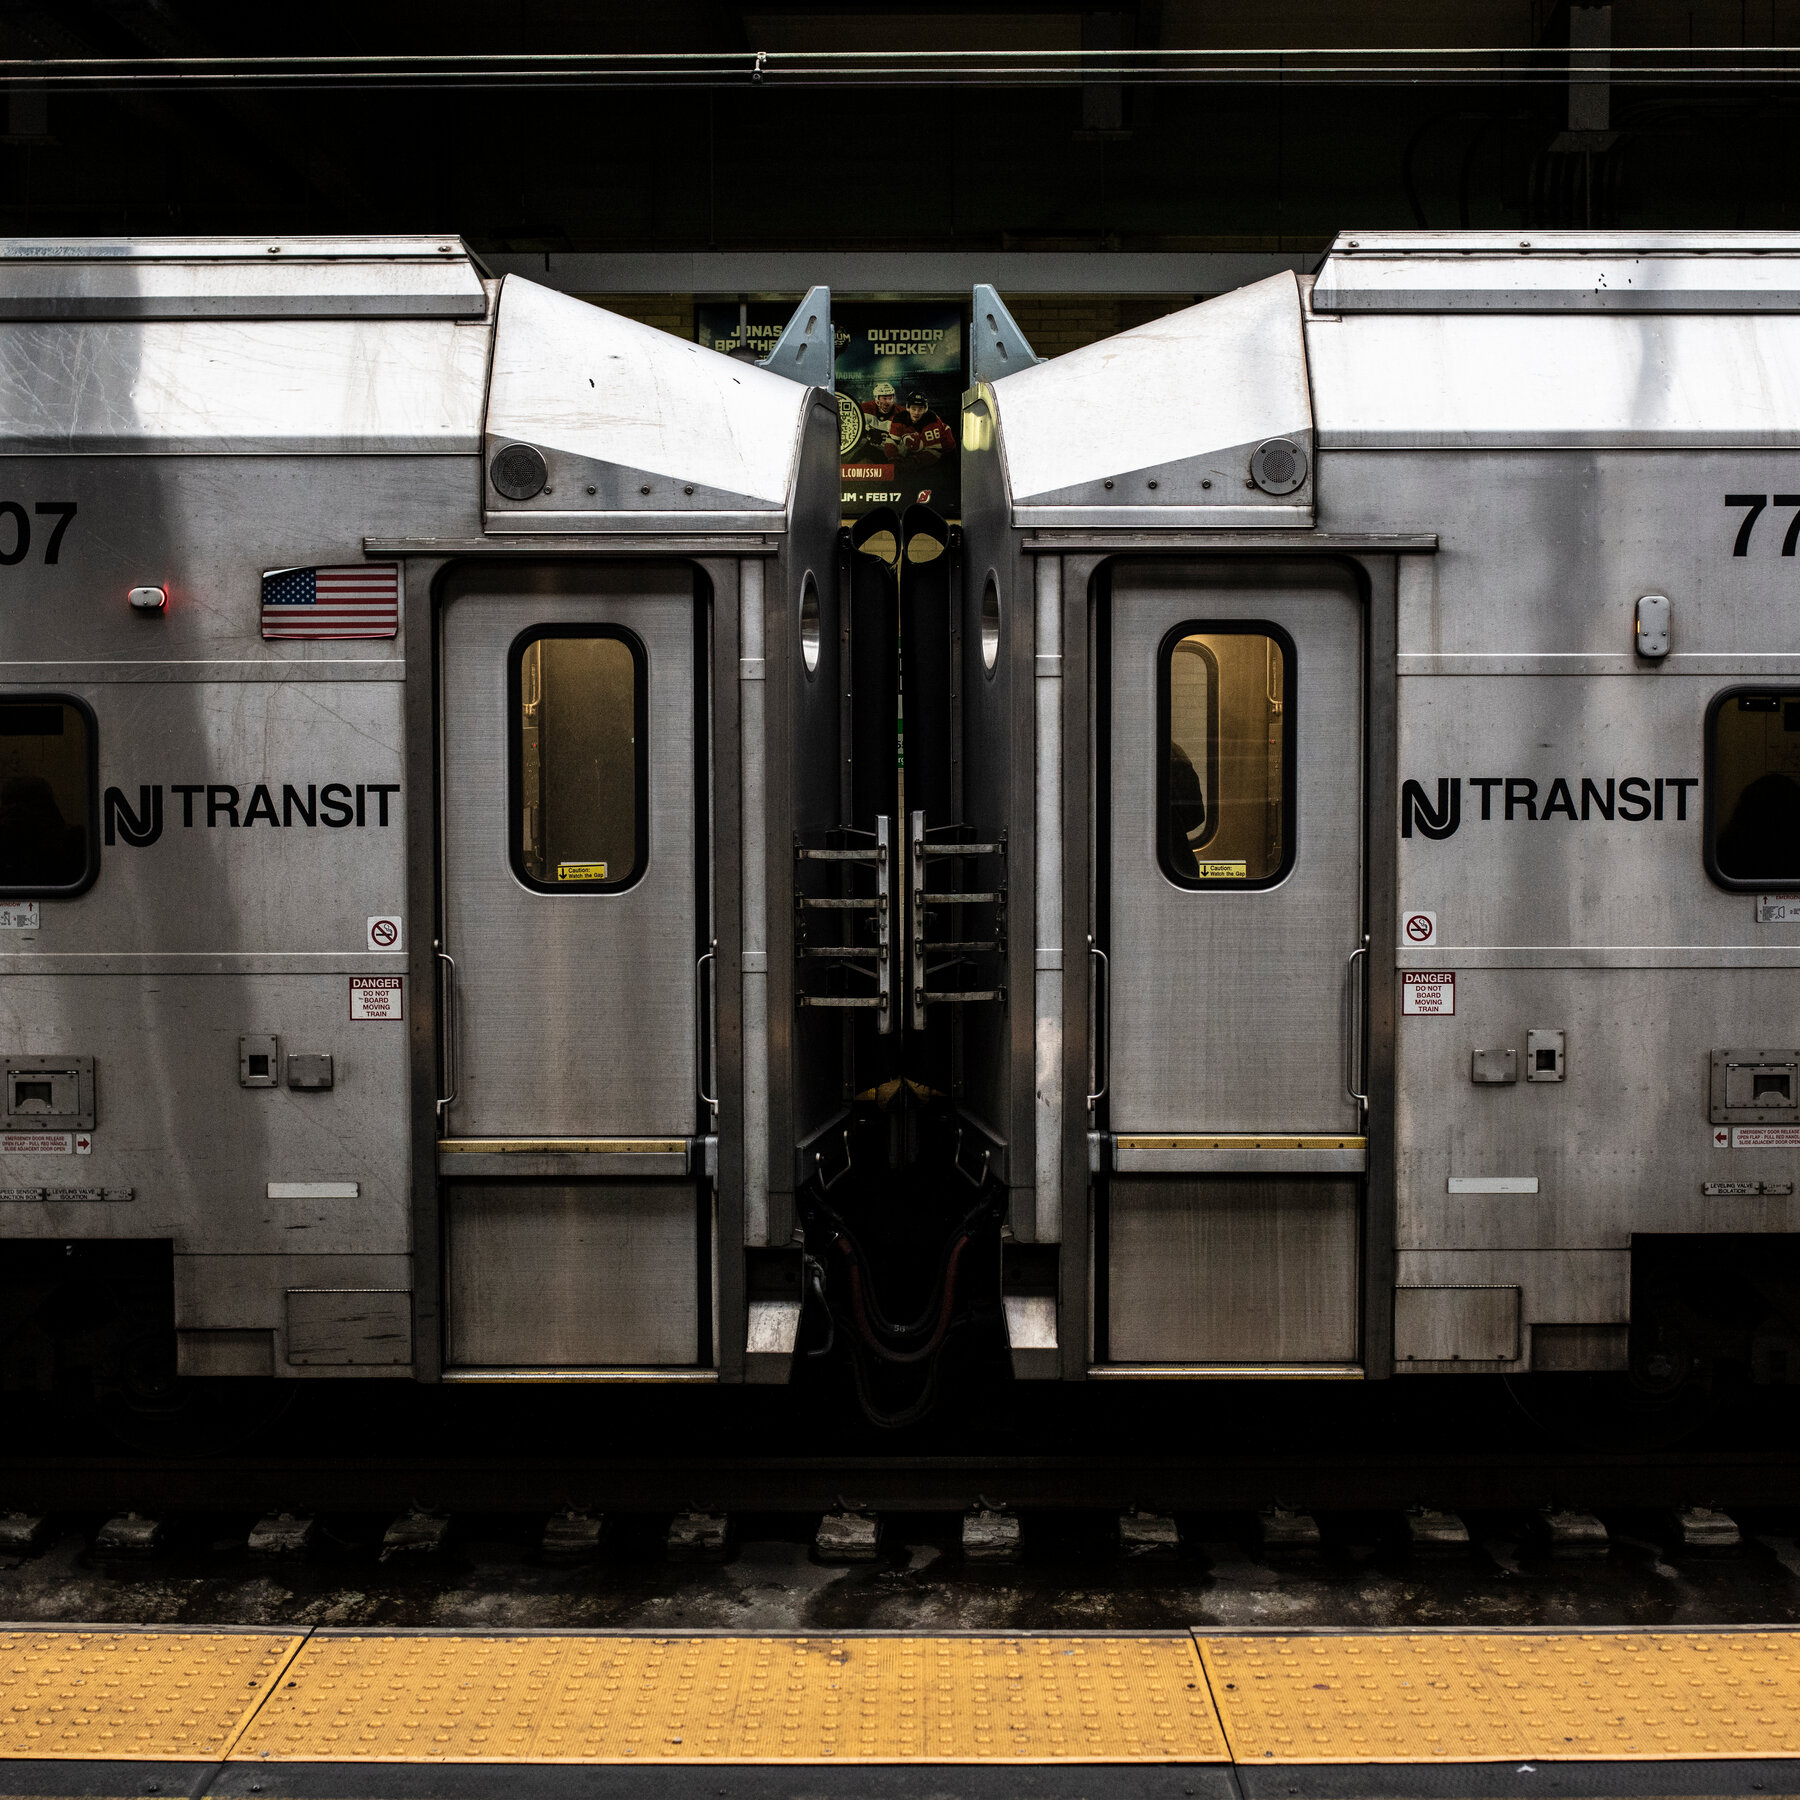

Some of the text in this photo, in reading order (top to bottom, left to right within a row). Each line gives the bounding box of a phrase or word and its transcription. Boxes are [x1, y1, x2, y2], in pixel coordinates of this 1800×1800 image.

[867, 329, 944, 341] OUTDOOR
[715, 340, 778, 352] BRTHE
[874, 343, 937, 355] HOCKEY
[924, 428, 941, 441] 86
[865, 492, 888, 502] FEB
[889, 492, 902, 502] 17
[1724, 494, 1800, 557] 77
[0, 501, 78, 566] 07
[1469, 776, 1699, 822] TRANSIT
[171, 783, 400, 828] TRANSIT
[353, 978, 399, 988] DANGER
[1405, 973, 1452, 983] DANGER
